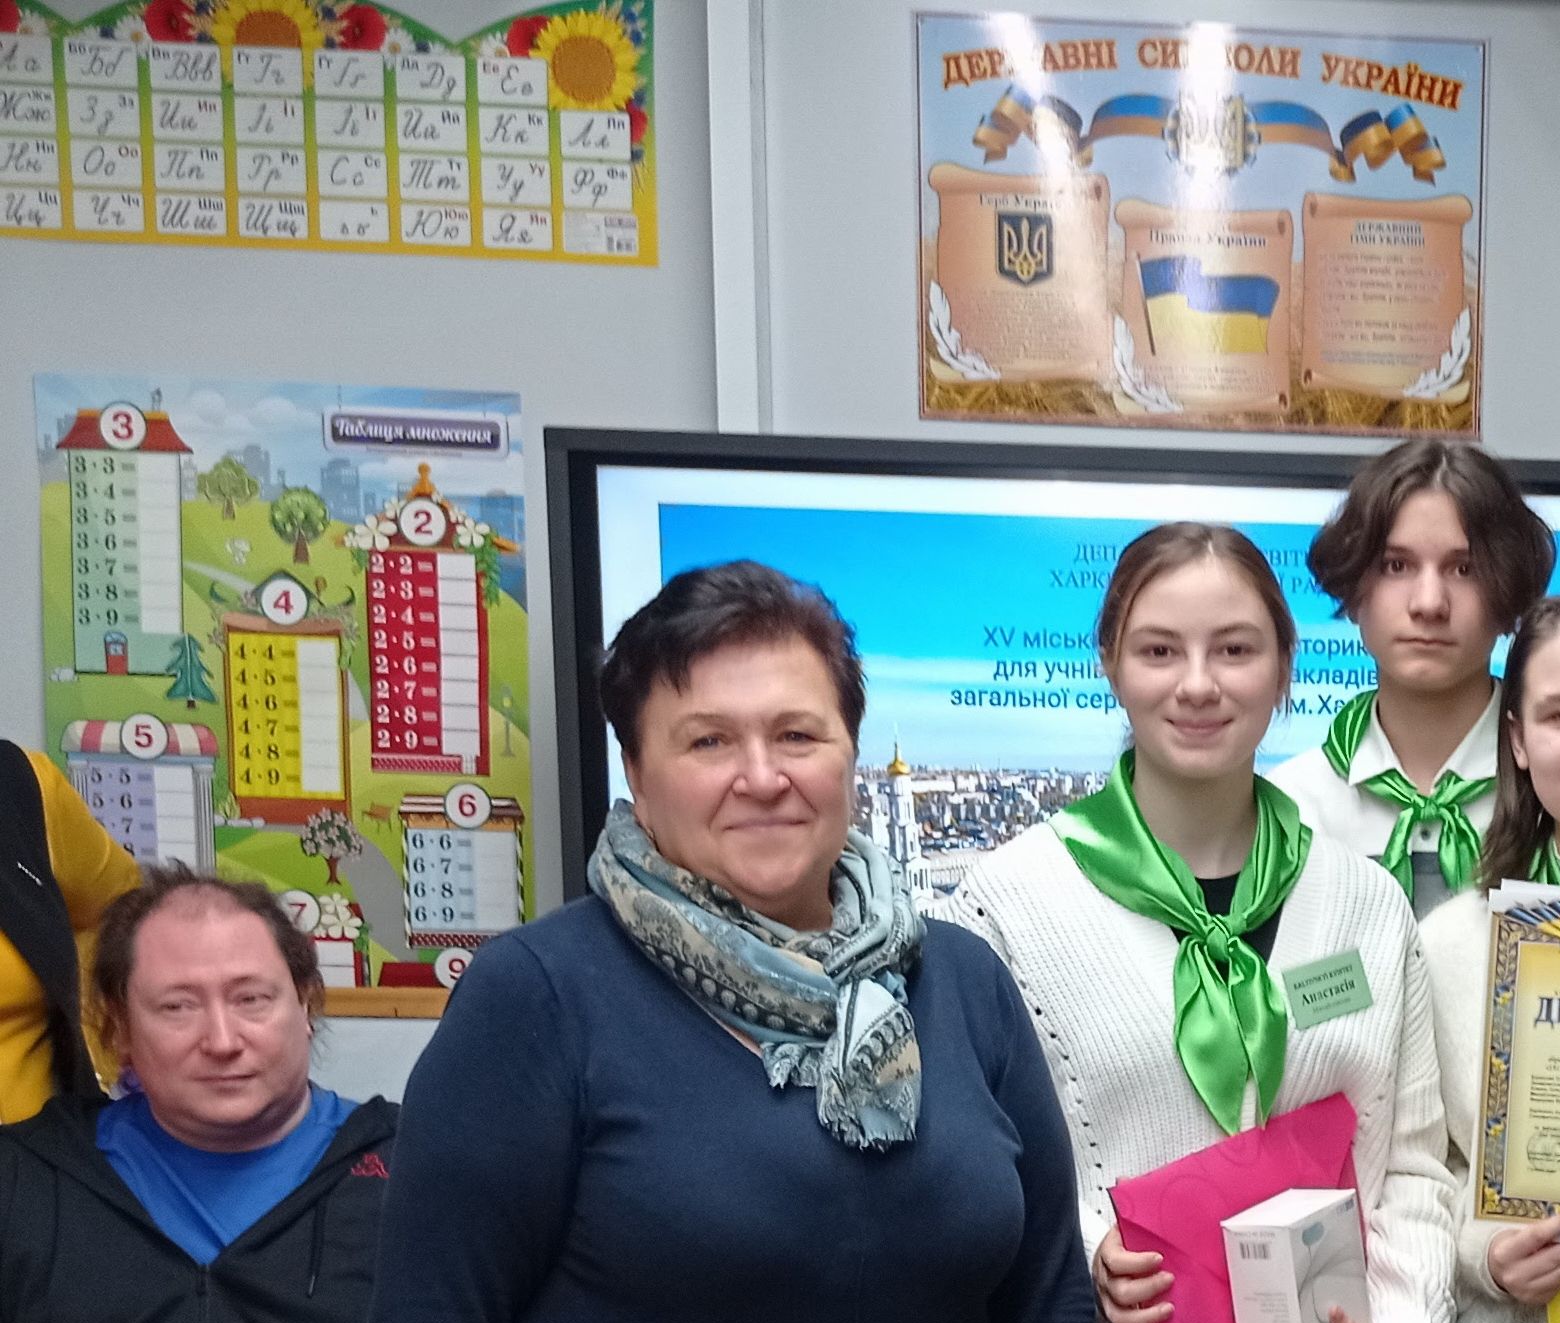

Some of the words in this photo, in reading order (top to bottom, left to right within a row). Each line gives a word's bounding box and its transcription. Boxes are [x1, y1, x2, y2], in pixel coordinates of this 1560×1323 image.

[943, 39, 1117, 90] ДЕРАВНІ
[1137, 38, 1300, 79] СИОЛИ
[1321, 53, 1464, 110] УКРАЇНИ
[112, 411, 133, 440] 3
[336, 417, 404, 442] Таблиця
[406, 427, 492, 444] множення
[414, 510, 432, 535] 2
[1051, 569, 1110, 588] ХАРК
[273, 590, 293, 615] 4
[984, 625, 1015, 647] XV
[1023, 629, 1096, 649] міськ
[994, 660, 1037, 681] для
[1291, 666, 1379, 689] акладів
[950, 688, 1070, 709] загальної
[1076, 692, 1118, 714] сер
[134, 724, 153, 748] 5
[459, 794, 477, 817] 6
[289, 903, 306, 924] 7
